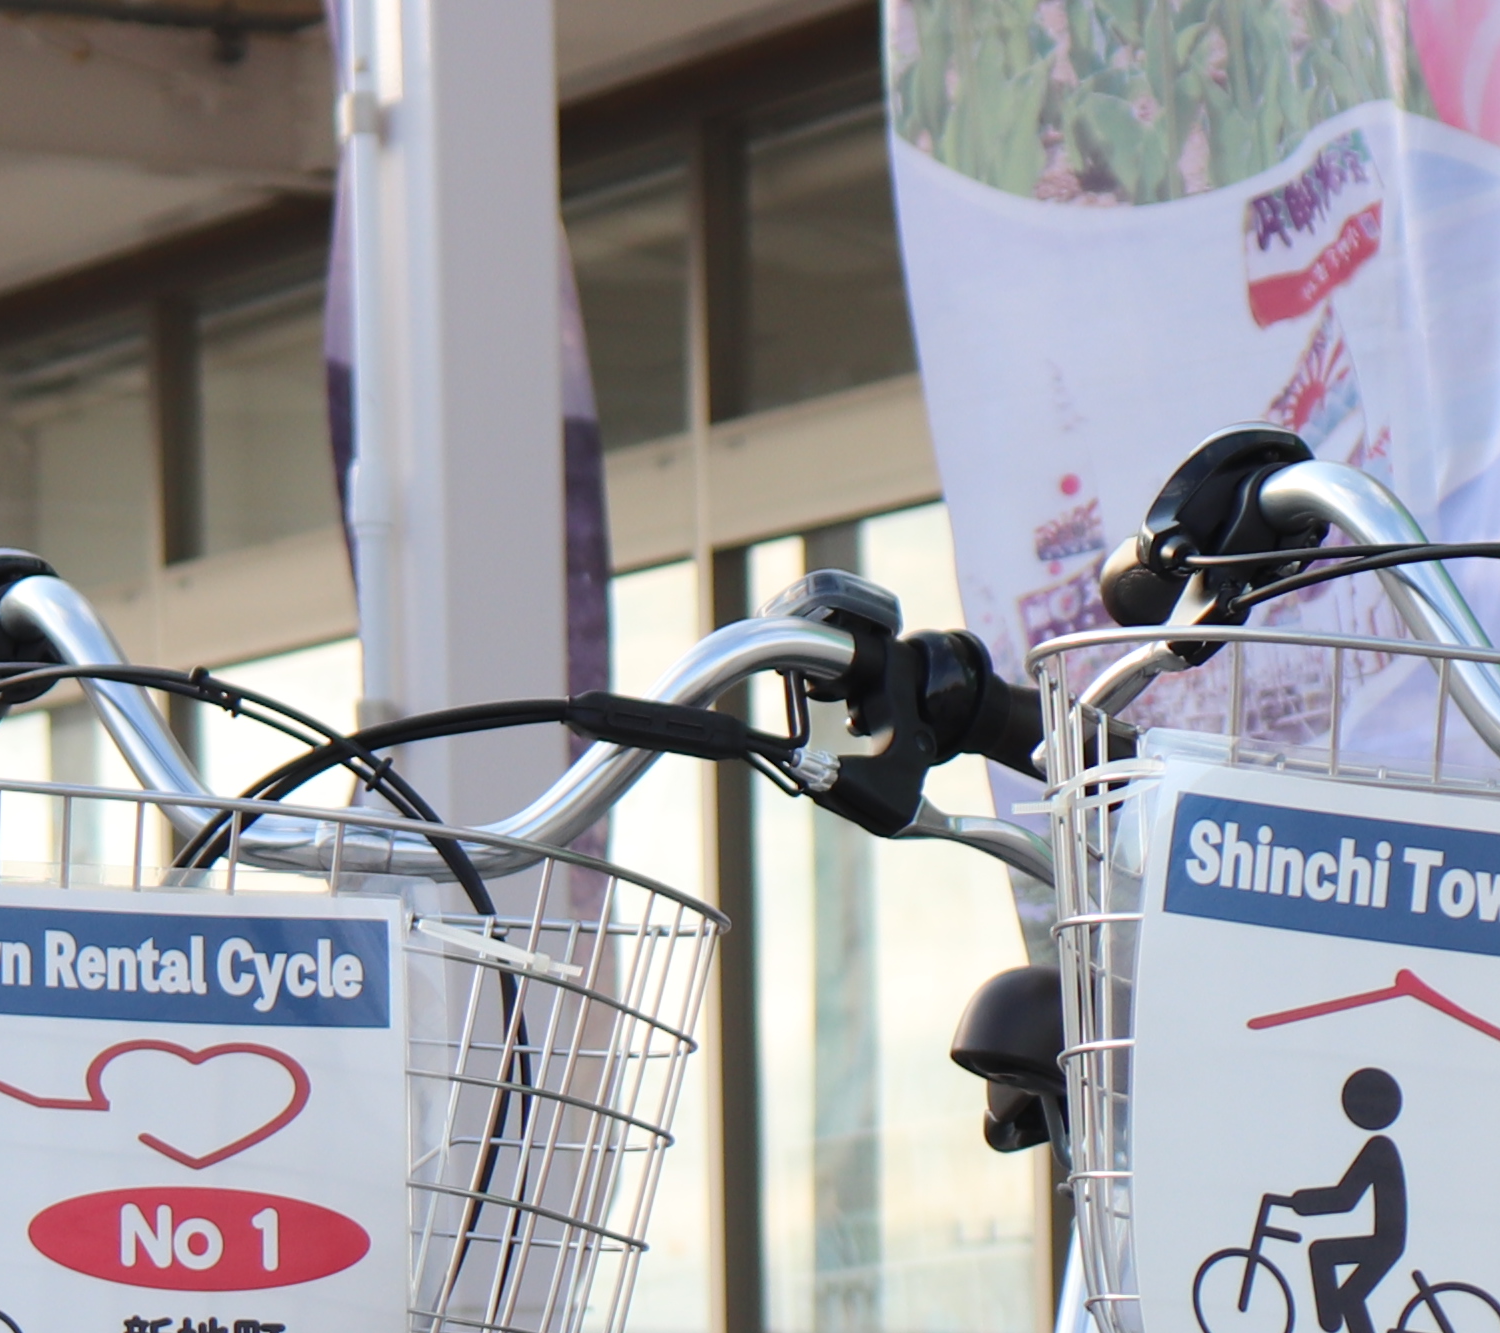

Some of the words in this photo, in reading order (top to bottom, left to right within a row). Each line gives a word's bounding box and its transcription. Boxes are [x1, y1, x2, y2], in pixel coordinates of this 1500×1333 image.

[1185, 820, 1392, 908] Shinchi
[46, 930, 207, 995] Rental
[218, 938, 363, 1012] Cycle
[120, 1203, 224, 1271] No
[251, 1207, 280, 1272] 1
